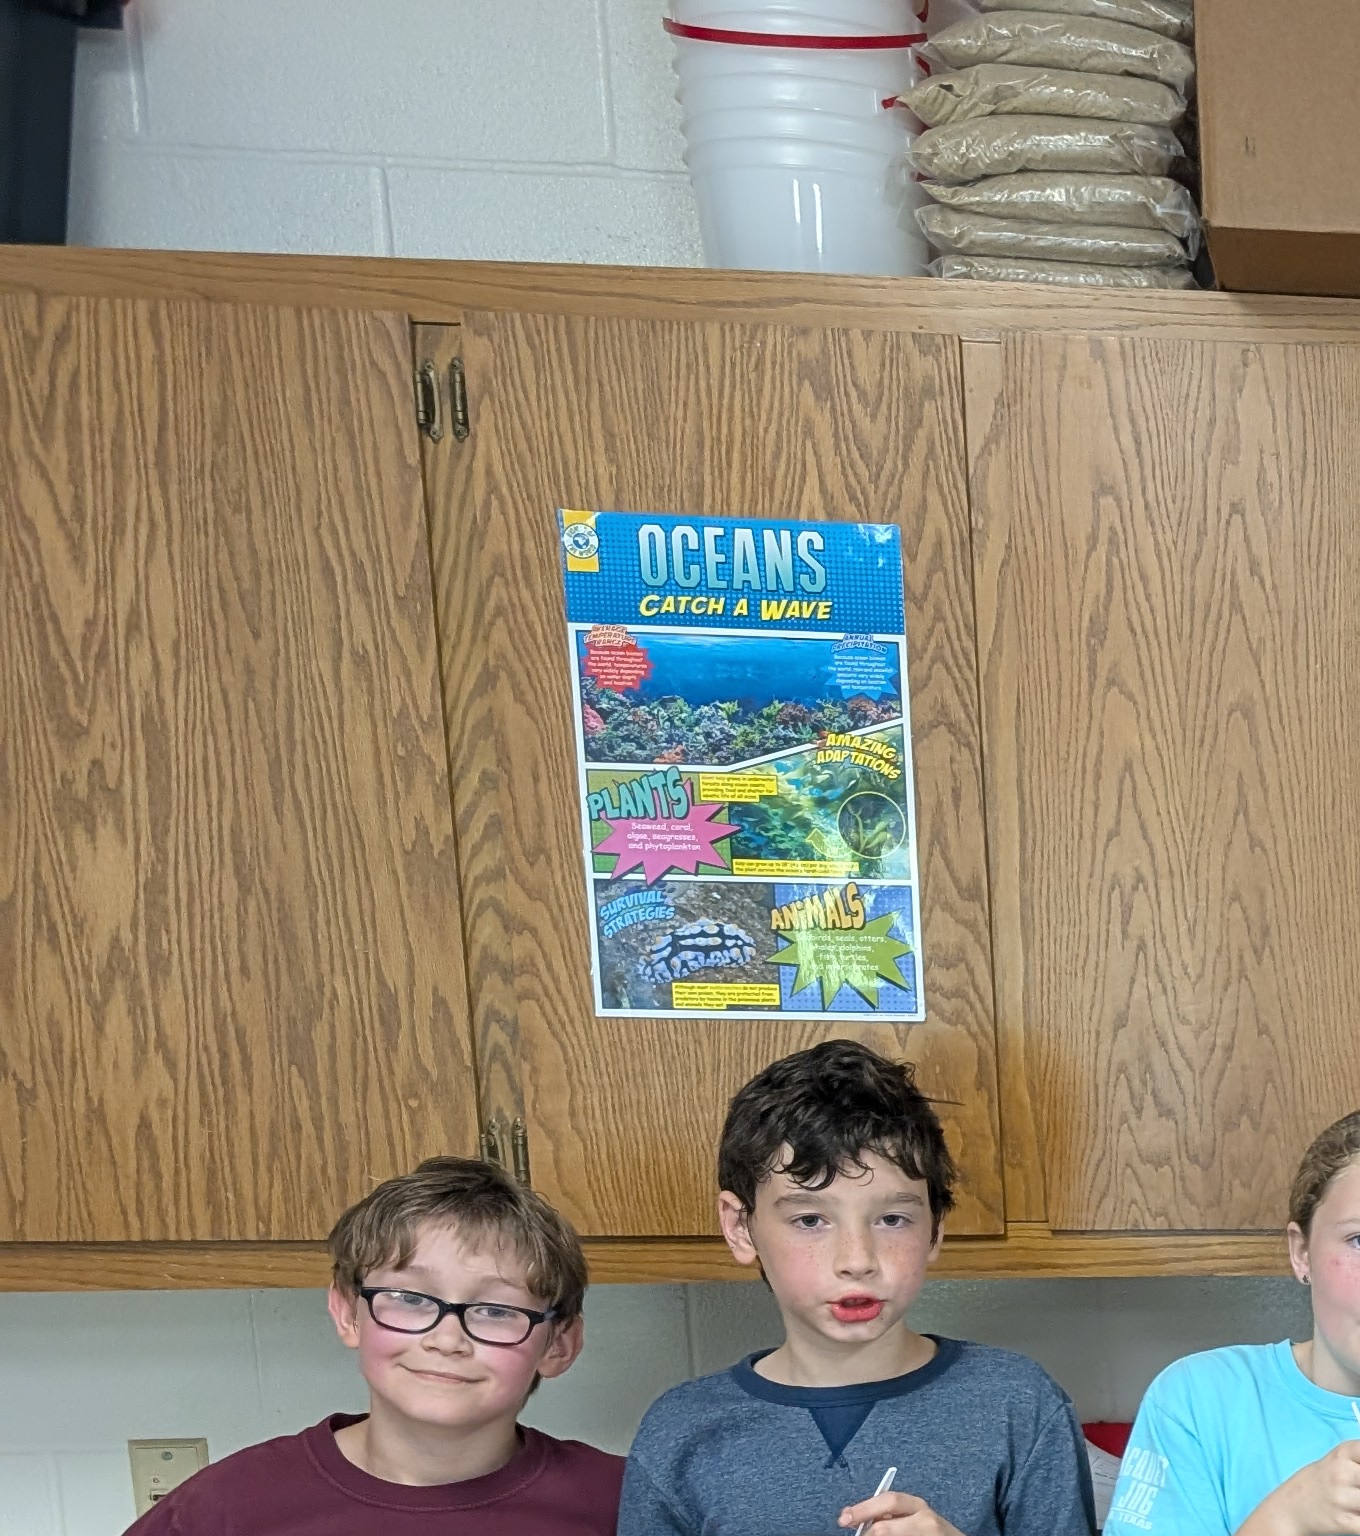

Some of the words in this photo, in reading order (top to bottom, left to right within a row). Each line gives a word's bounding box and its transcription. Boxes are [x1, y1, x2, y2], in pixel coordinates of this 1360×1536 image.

[638, 523, 827, 593] OCEANS
[639, 594, 725, 617] CATCH
[733, 602, 749, 616] A
[761, 599, 833, 620] WAVE
[826, 733, 896, 759] AMAZING
[816, 751, 901, 780] ADAPTATIONS
[586, 765, 690, 820] PLANTS
[631, 822, 669, 832] Seaweed,
[671, 823, 694, 832] coral,
[600, 890, 665, 920] SURVIVAL
[771, 882, 866, 930] ANIMALS
[603, 906, 675, 938] STRATEGIES
[1117, 1480, 1159, 1515] JOG
[1118, 1512, 1153, 1530] TEXAS
